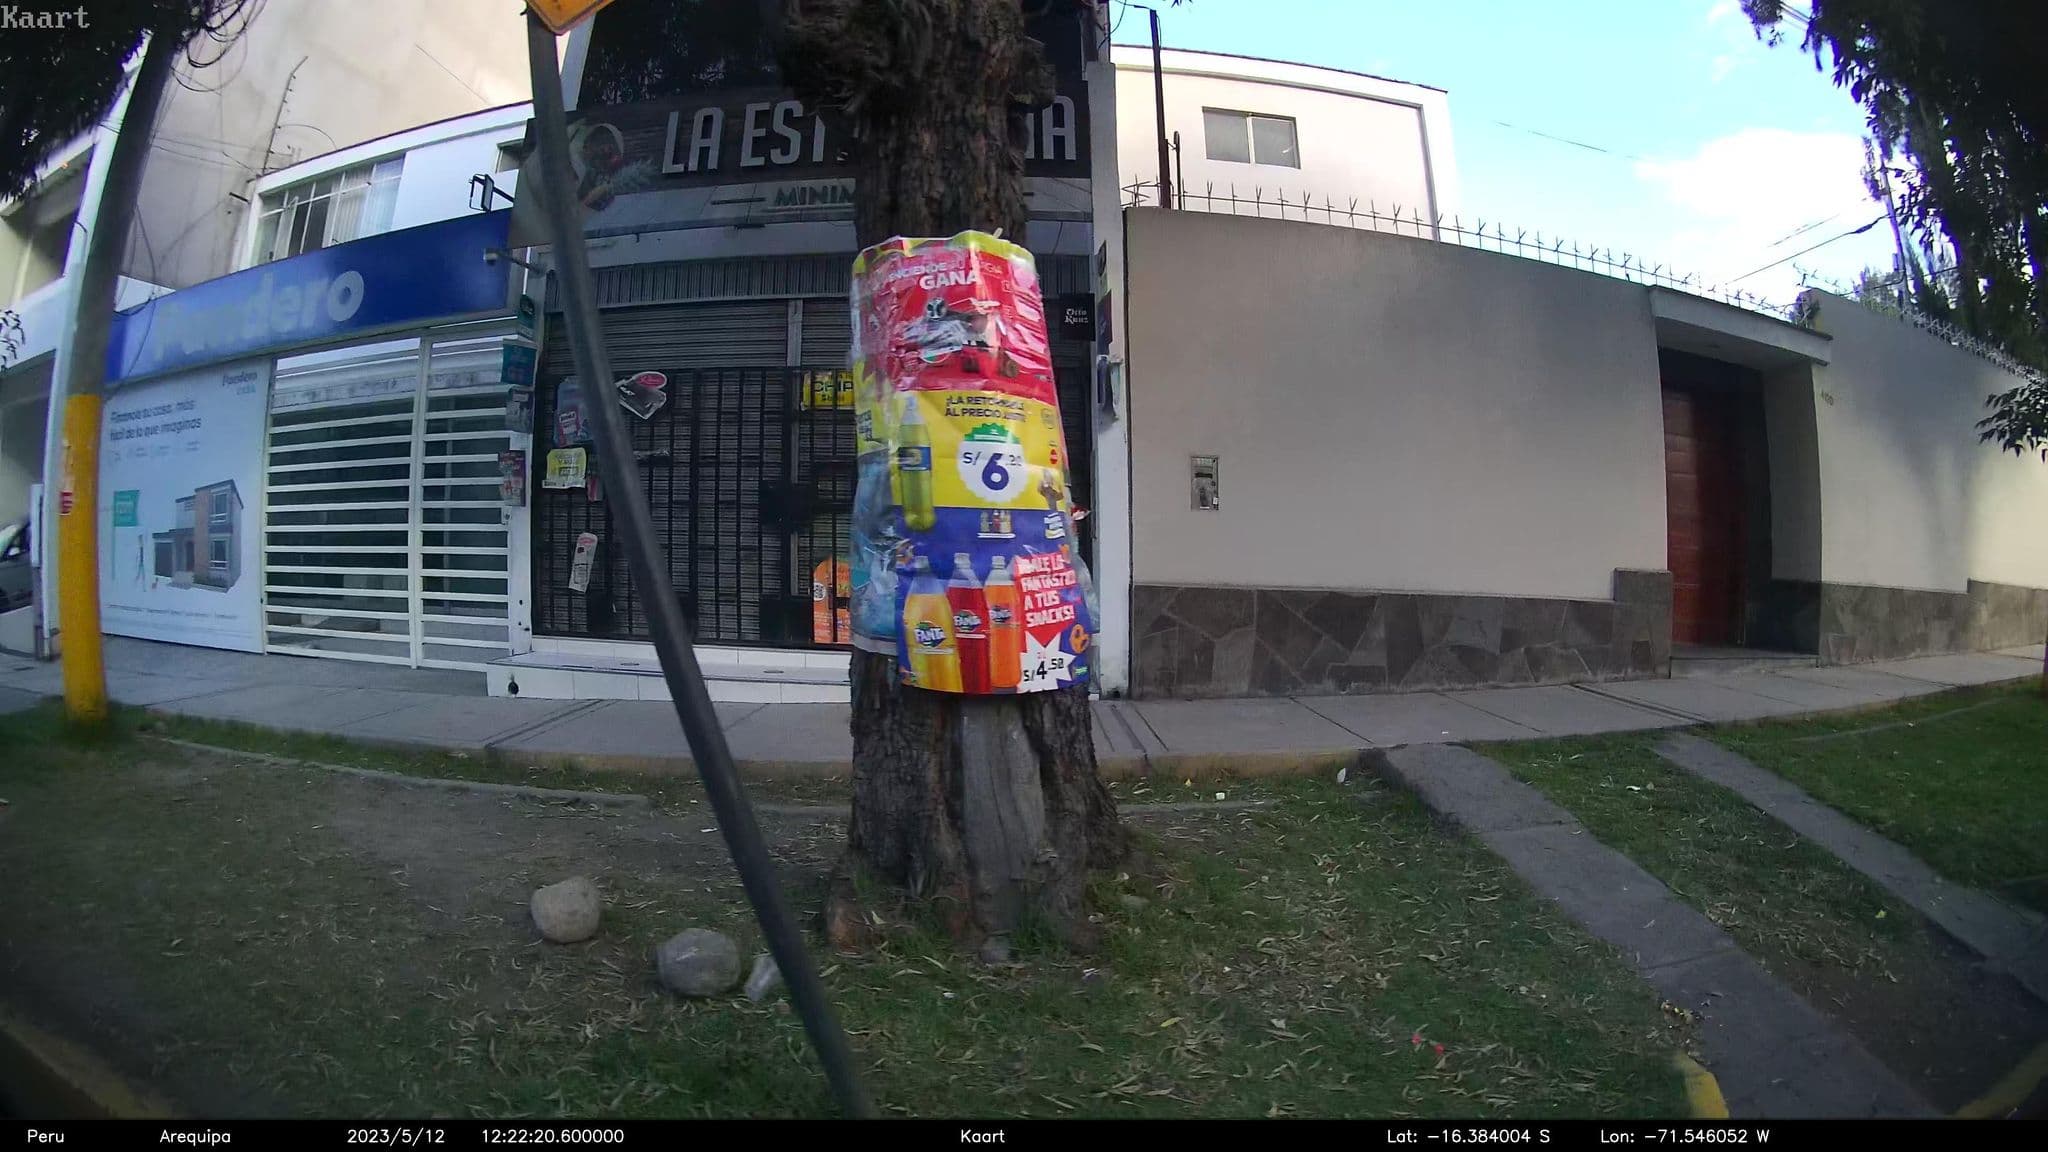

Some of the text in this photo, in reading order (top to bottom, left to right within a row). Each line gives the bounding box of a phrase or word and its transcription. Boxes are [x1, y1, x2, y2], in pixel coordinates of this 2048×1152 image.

[662, 106, 724, 173] LA
[919, 268, 979, 291] GANA
[945, 408, 960, 417] AL
[962, 408, 1001, 418] PRECIO
[1035, 590, 1060, 608] TUS
